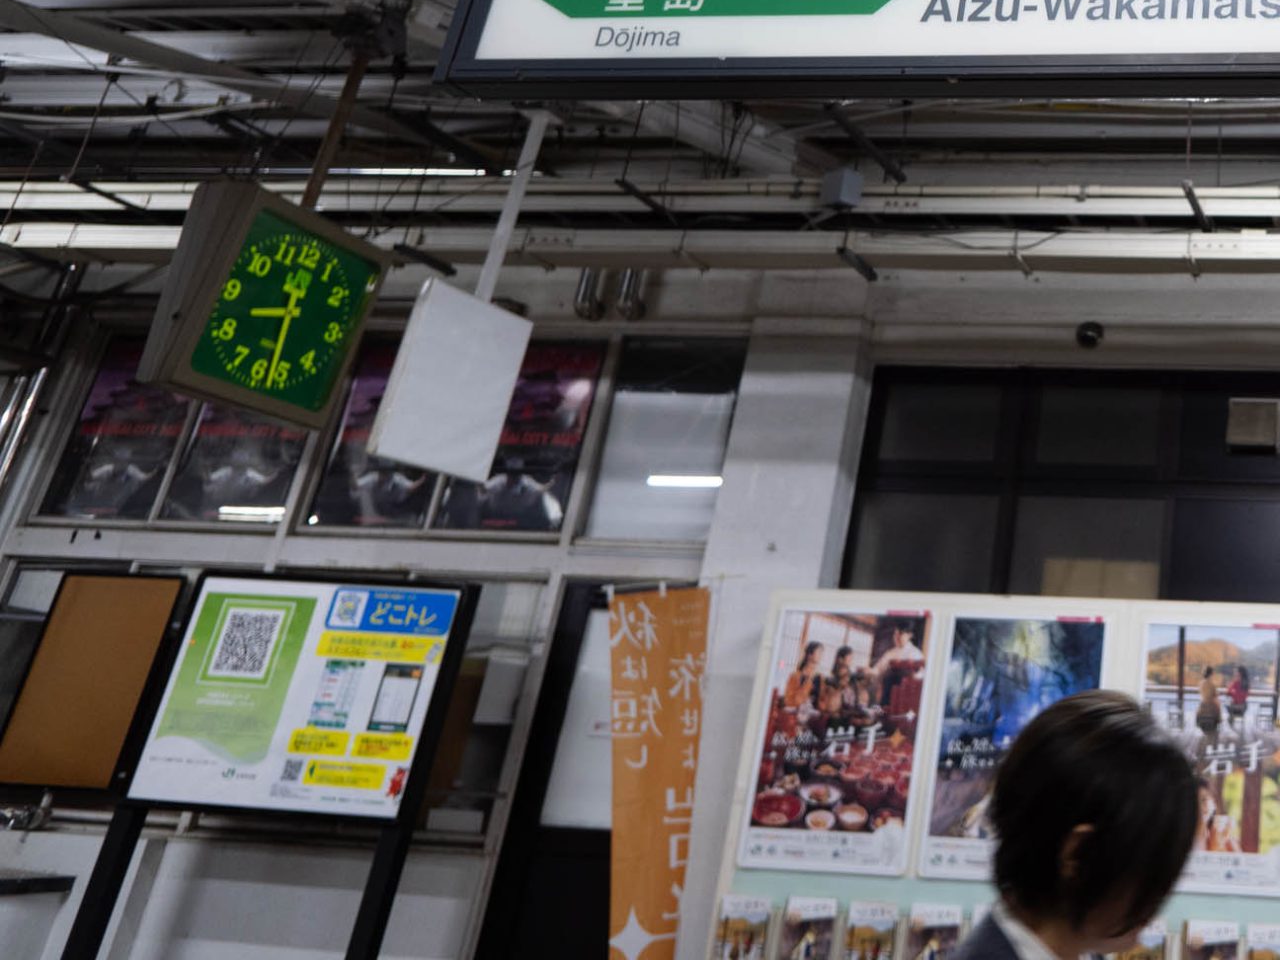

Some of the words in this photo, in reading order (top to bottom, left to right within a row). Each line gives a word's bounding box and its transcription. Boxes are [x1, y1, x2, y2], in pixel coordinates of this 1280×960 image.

[595, 25, 681, 52] Dōjima
[247, 253, 271, 277] 10
[275, 242, 296, 266] 11
[298, 245, 320, 269] 12
[321, 263, 333, 282] 1
[223, 279, 241, 300] 9
[327, 287, 344, 307] 2
[219, 318, 237, 340] 8
[324, 322, 340, 343] 3
[232, 345, 250, 367] 7
[300, 350, 316, 370] 4
[251, 359, 268, 381] 6
[274, 361, 291, 381] 5
[370, 602, 437, 626] どこトレ
[822, 722, 886, 757] 岩手
[1202, 740, 1269, 775] 岩手
